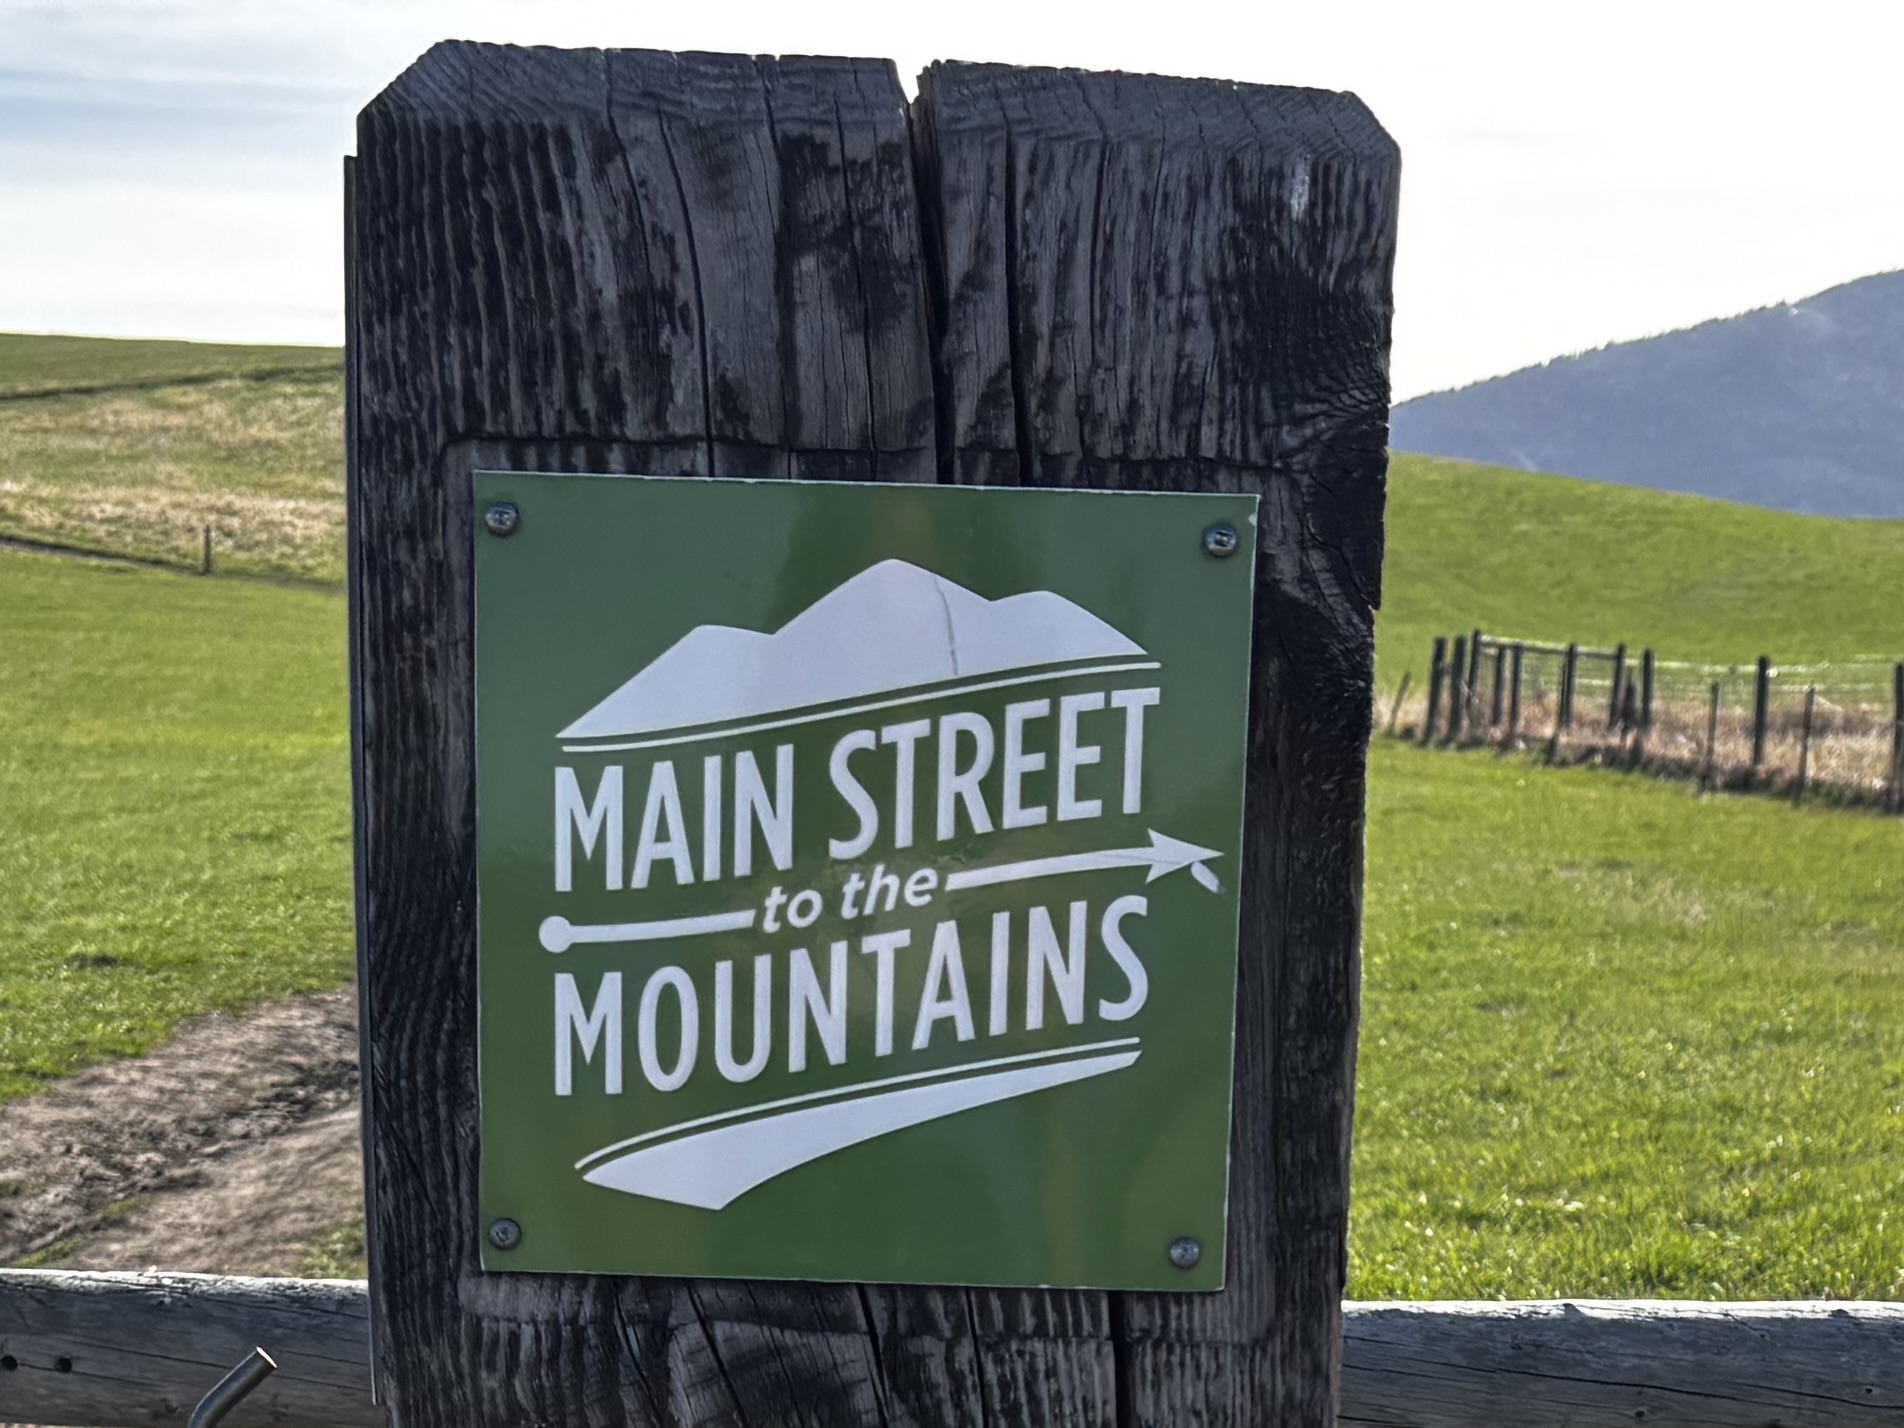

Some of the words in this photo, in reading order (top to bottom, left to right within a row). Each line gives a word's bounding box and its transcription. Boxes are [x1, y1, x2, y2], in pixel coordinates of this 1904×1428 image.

[554, 744, 795, 892] MAIN
[828, 687, 1161, 861] STREET
[554, 895, 1149, 1096] MOUNTAINS
[763, 888, 824, 932] to
[841, 863, 938, 916] the
